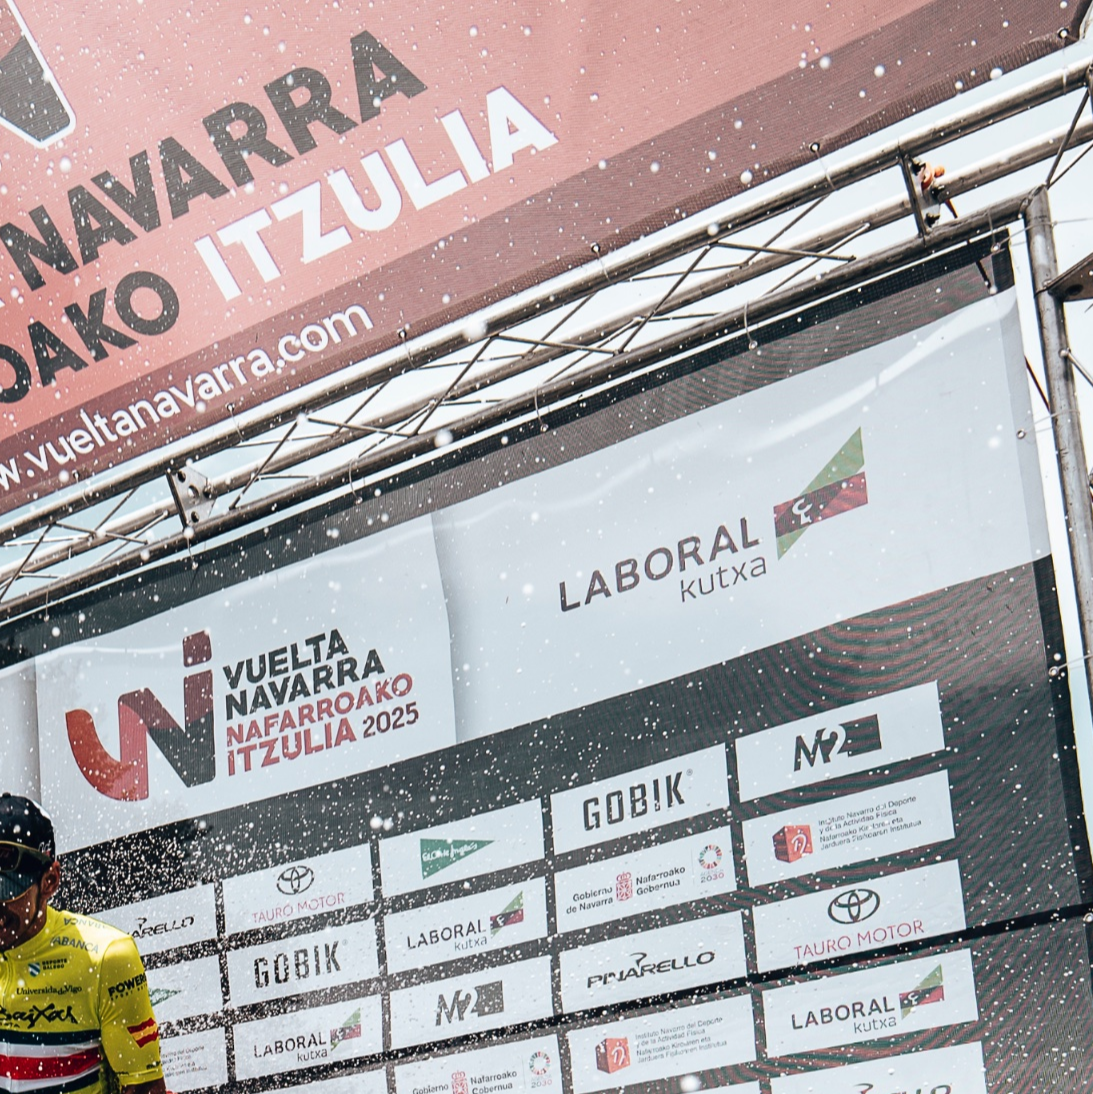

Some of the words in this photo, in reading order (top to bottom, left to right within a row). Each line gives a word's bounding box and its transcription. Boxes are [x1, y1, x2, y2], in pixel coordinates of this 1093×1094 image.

[195, 87, 558, 301] ITZULIA
[559, 518, 759, 612] LABORAL
[681, 556, 766, 602] kutxa
[223, 629, 349, 689] VUELTA
[226, 649, 385, 720] NAVARRA
[227, 673, 413, 746] NAFARROAKO
[228, 718, 356, 776] ITZULIA
[363, 702, 419, 739] 2025
[583, 771, 685, 831] GOBIK
[252, 903, 293, 924] TAURO
[298, 892, 345, 915] MOTOR
[573, 888, 612, 902] Gobierno
[580, 897, 613, 912] Navarra
[128, 917, 194, 938] ARELLO
[407, 920, 486, 950] LABORAL
[454, 937, 488, 952] kutxa
[794, 935, 851, 960] TAURO
[857, 920, 924, 946] MOTOR
[254, 941, 340, 988] GOBIK
[587, 952, 715, 989] PINARELLO
[792, 996, 895, 1030] LABORAL
[854, 1016, 897, 1034] kutxa
[254, 1032, 327, 1058] LABORAL
[297, 1049, 327, 1063] kutxa
